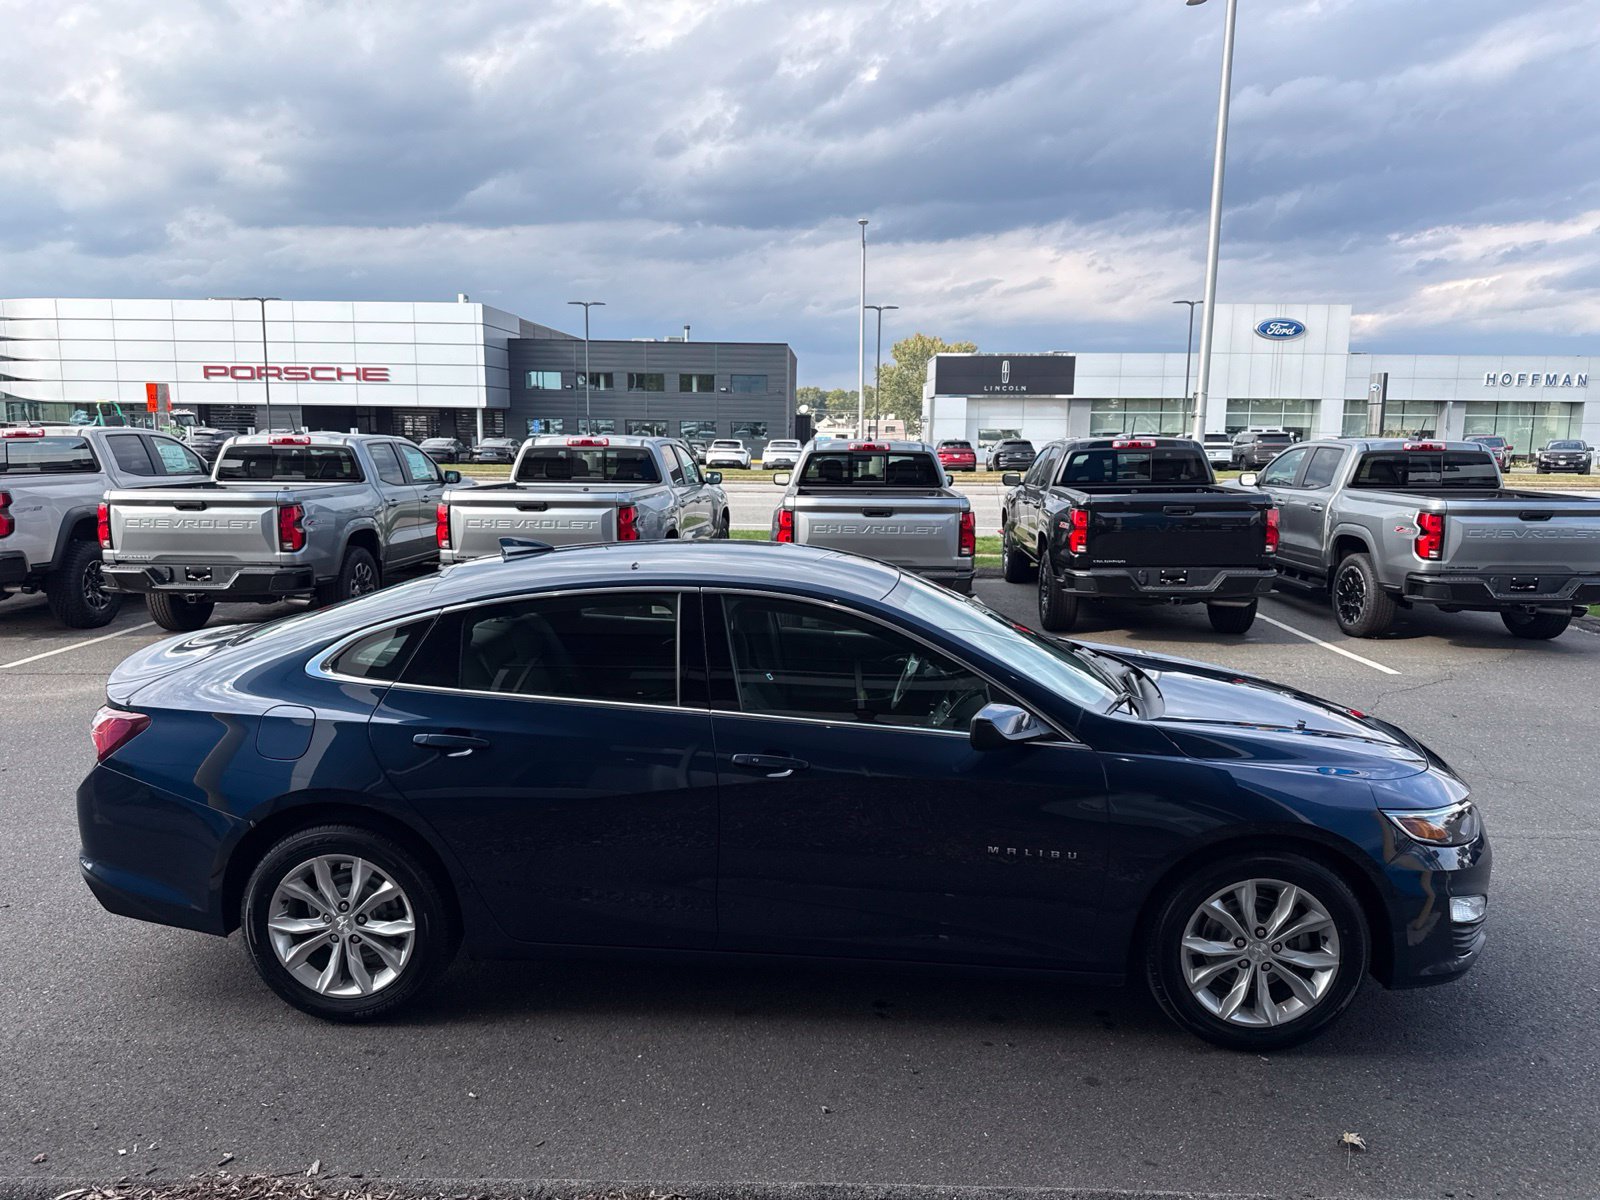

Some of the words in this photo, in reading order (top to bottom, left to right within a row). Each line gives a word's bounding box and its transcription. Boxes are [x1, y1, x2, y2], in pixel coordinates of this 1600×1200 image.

[1266, 322, 1296, 335] Ford
[203, 365, 390, 382] PORSCHE
[1484, 372, 1588, 387] HOFFMAN
[125, 518, 257, 529] CHEVROLET
[466, 518, 598, 530] CHEVROLET
[812, 525, 943, 535] CHEVROLET
[987, 846, 1077, 859] MALIBU
